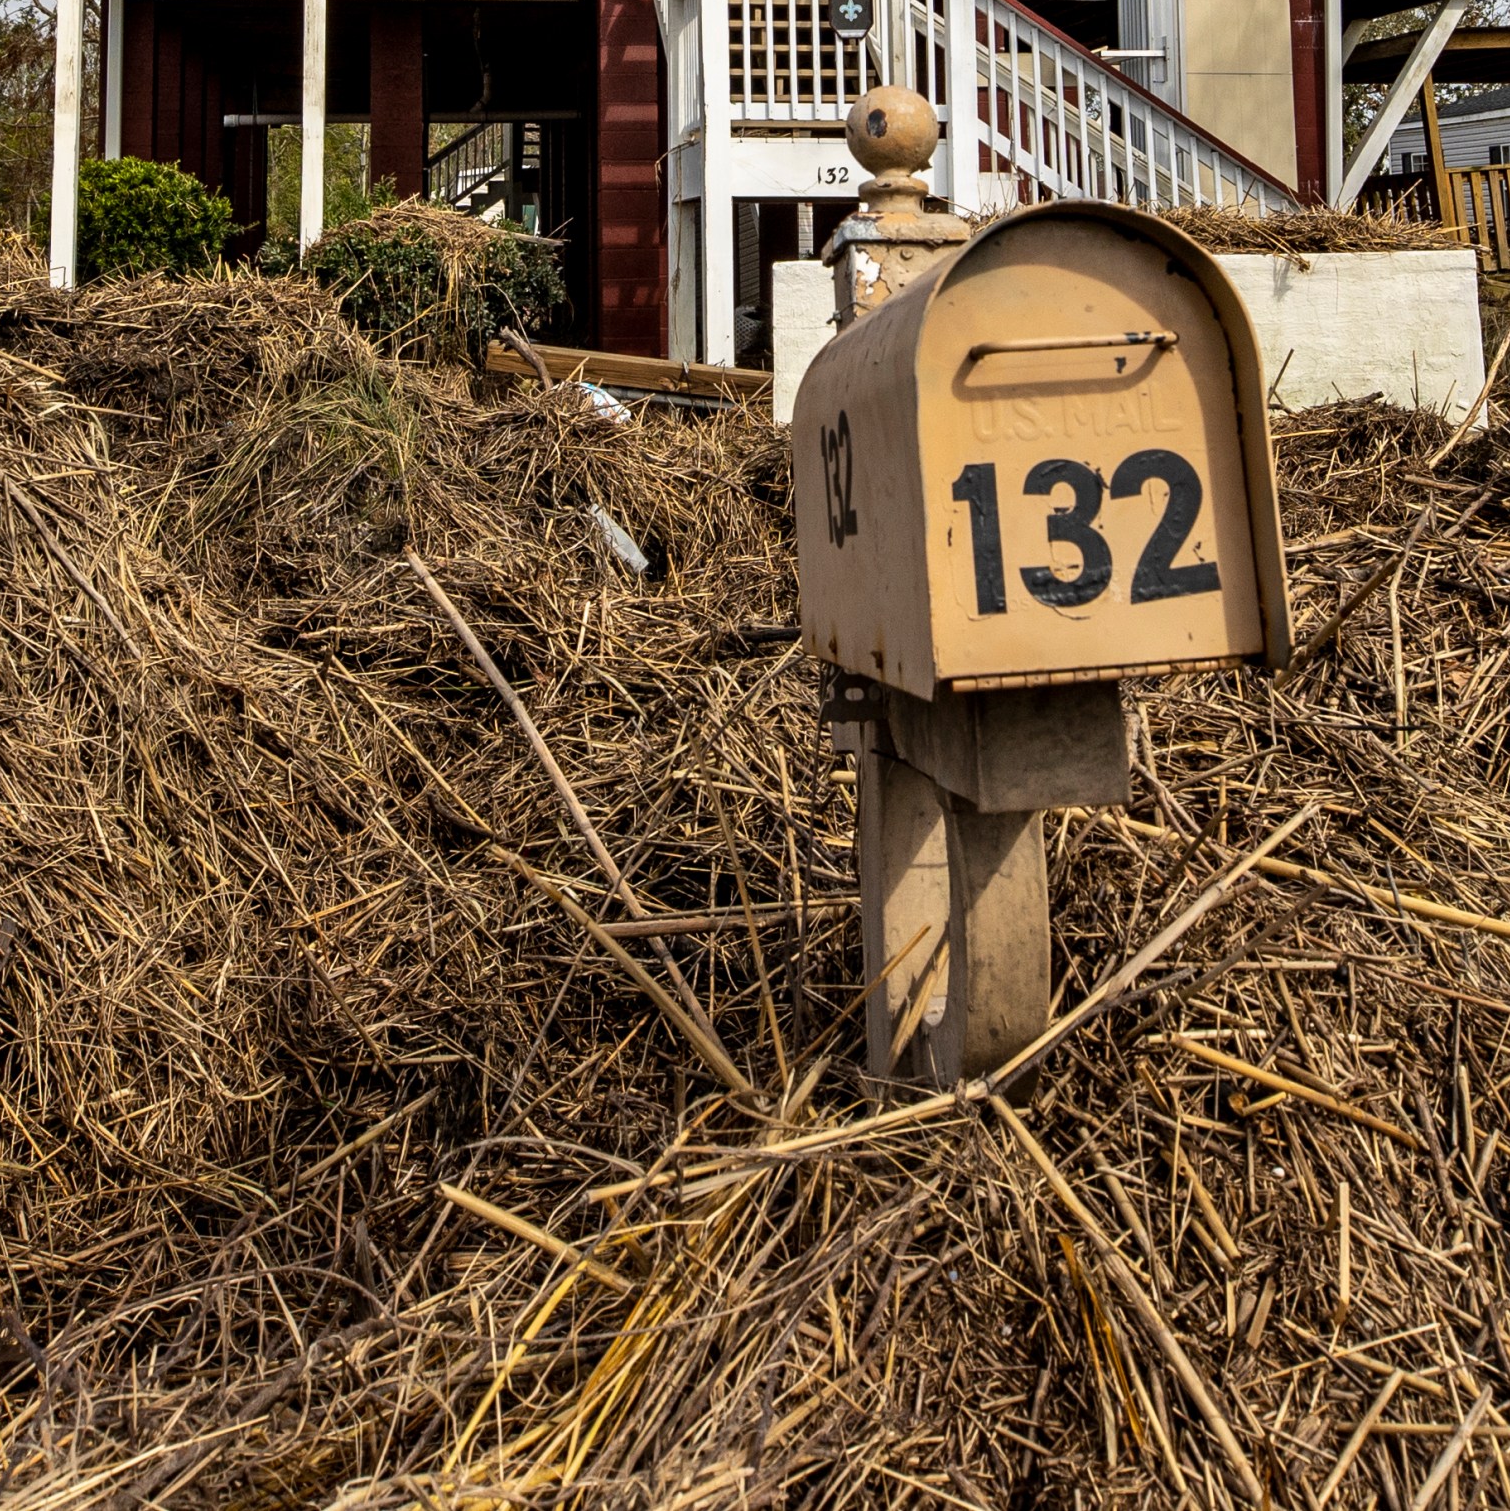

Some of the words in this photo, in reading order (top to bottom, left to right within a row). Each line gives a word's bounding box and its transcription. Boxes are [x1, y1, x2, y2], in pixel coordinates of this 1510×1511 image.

[817, 166, 850, 185] 132
[1061, 379, 1184, 439] MAIL
[820, 409, 858, 550] 132
[951, 448, 1223, 616] 132
